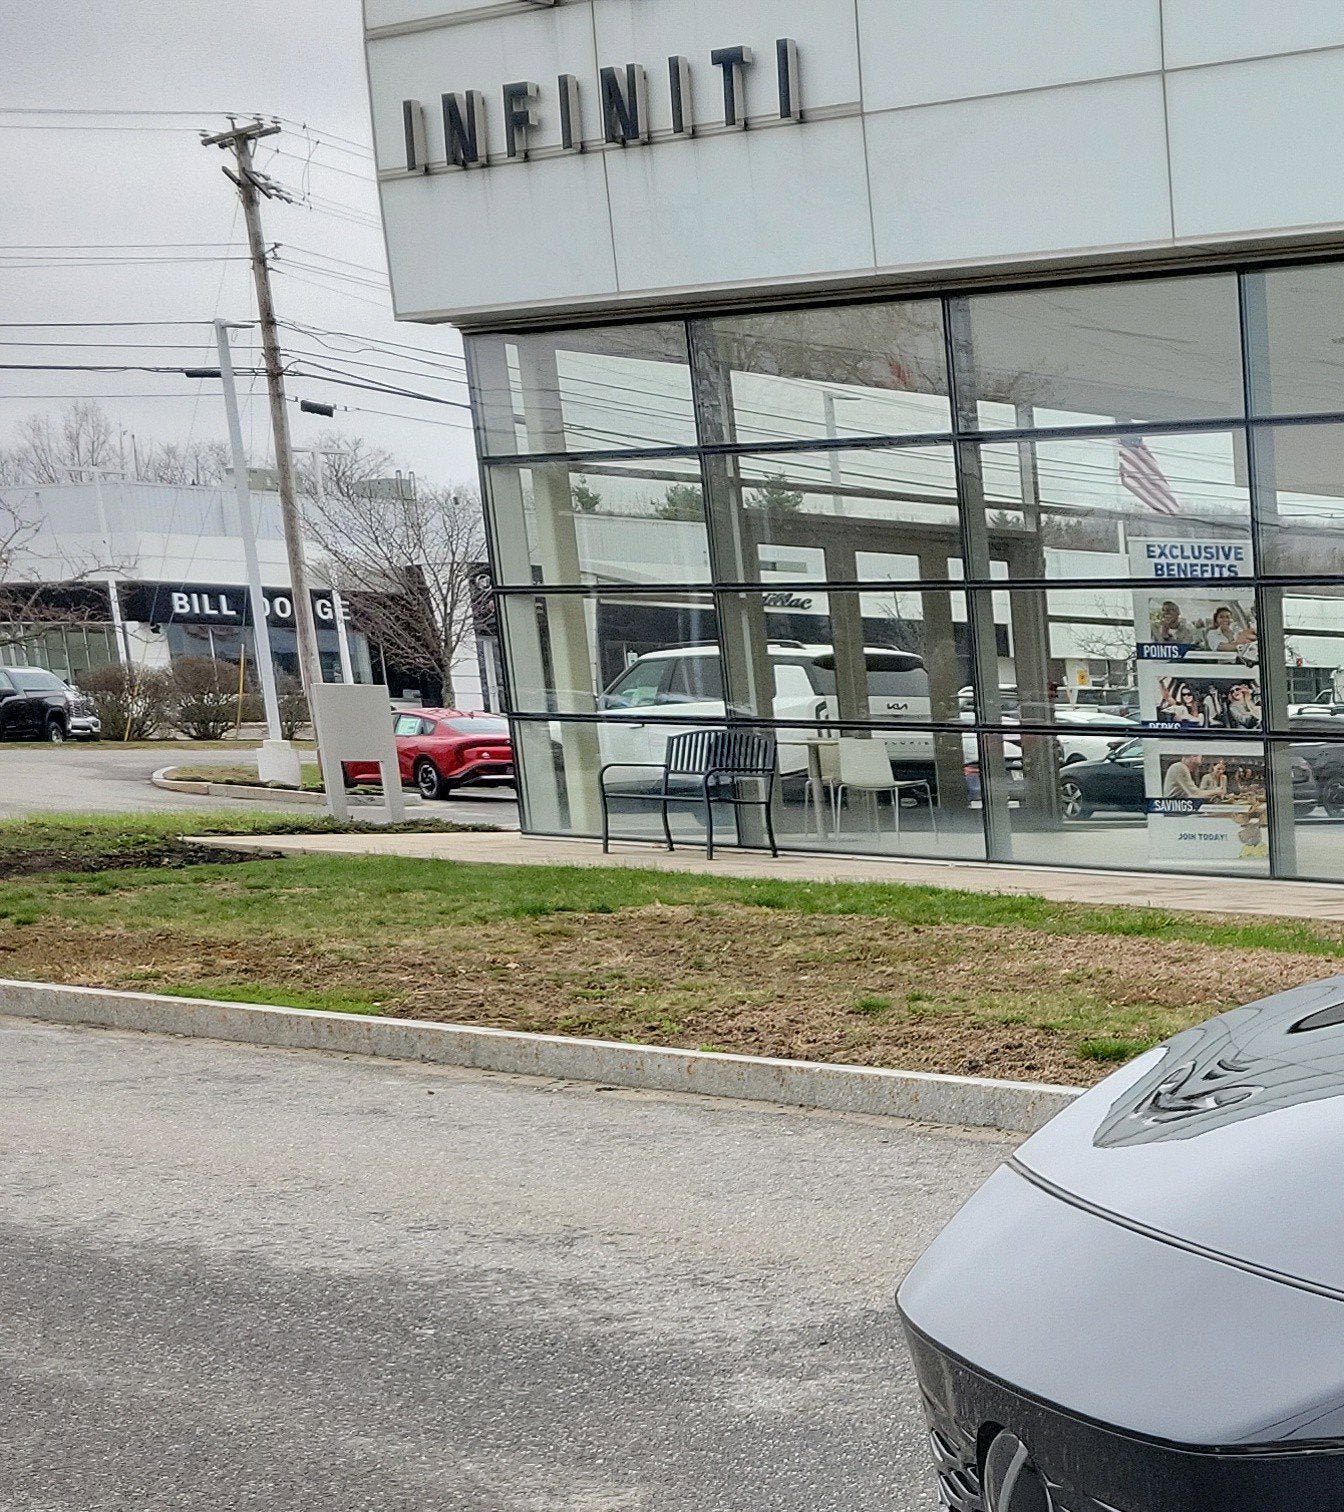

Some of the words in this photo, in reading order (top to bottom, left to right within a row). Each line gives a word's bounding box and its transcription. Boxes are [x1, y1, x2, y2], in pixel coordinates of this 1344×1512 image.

[402, 37, 799, 172] INFINITI
[1146, 543, 1245, 561] EXCLUSIVE
[1153, 562, 1239, 578] BENEFITS
[171, 591, 237, 616] BILL
